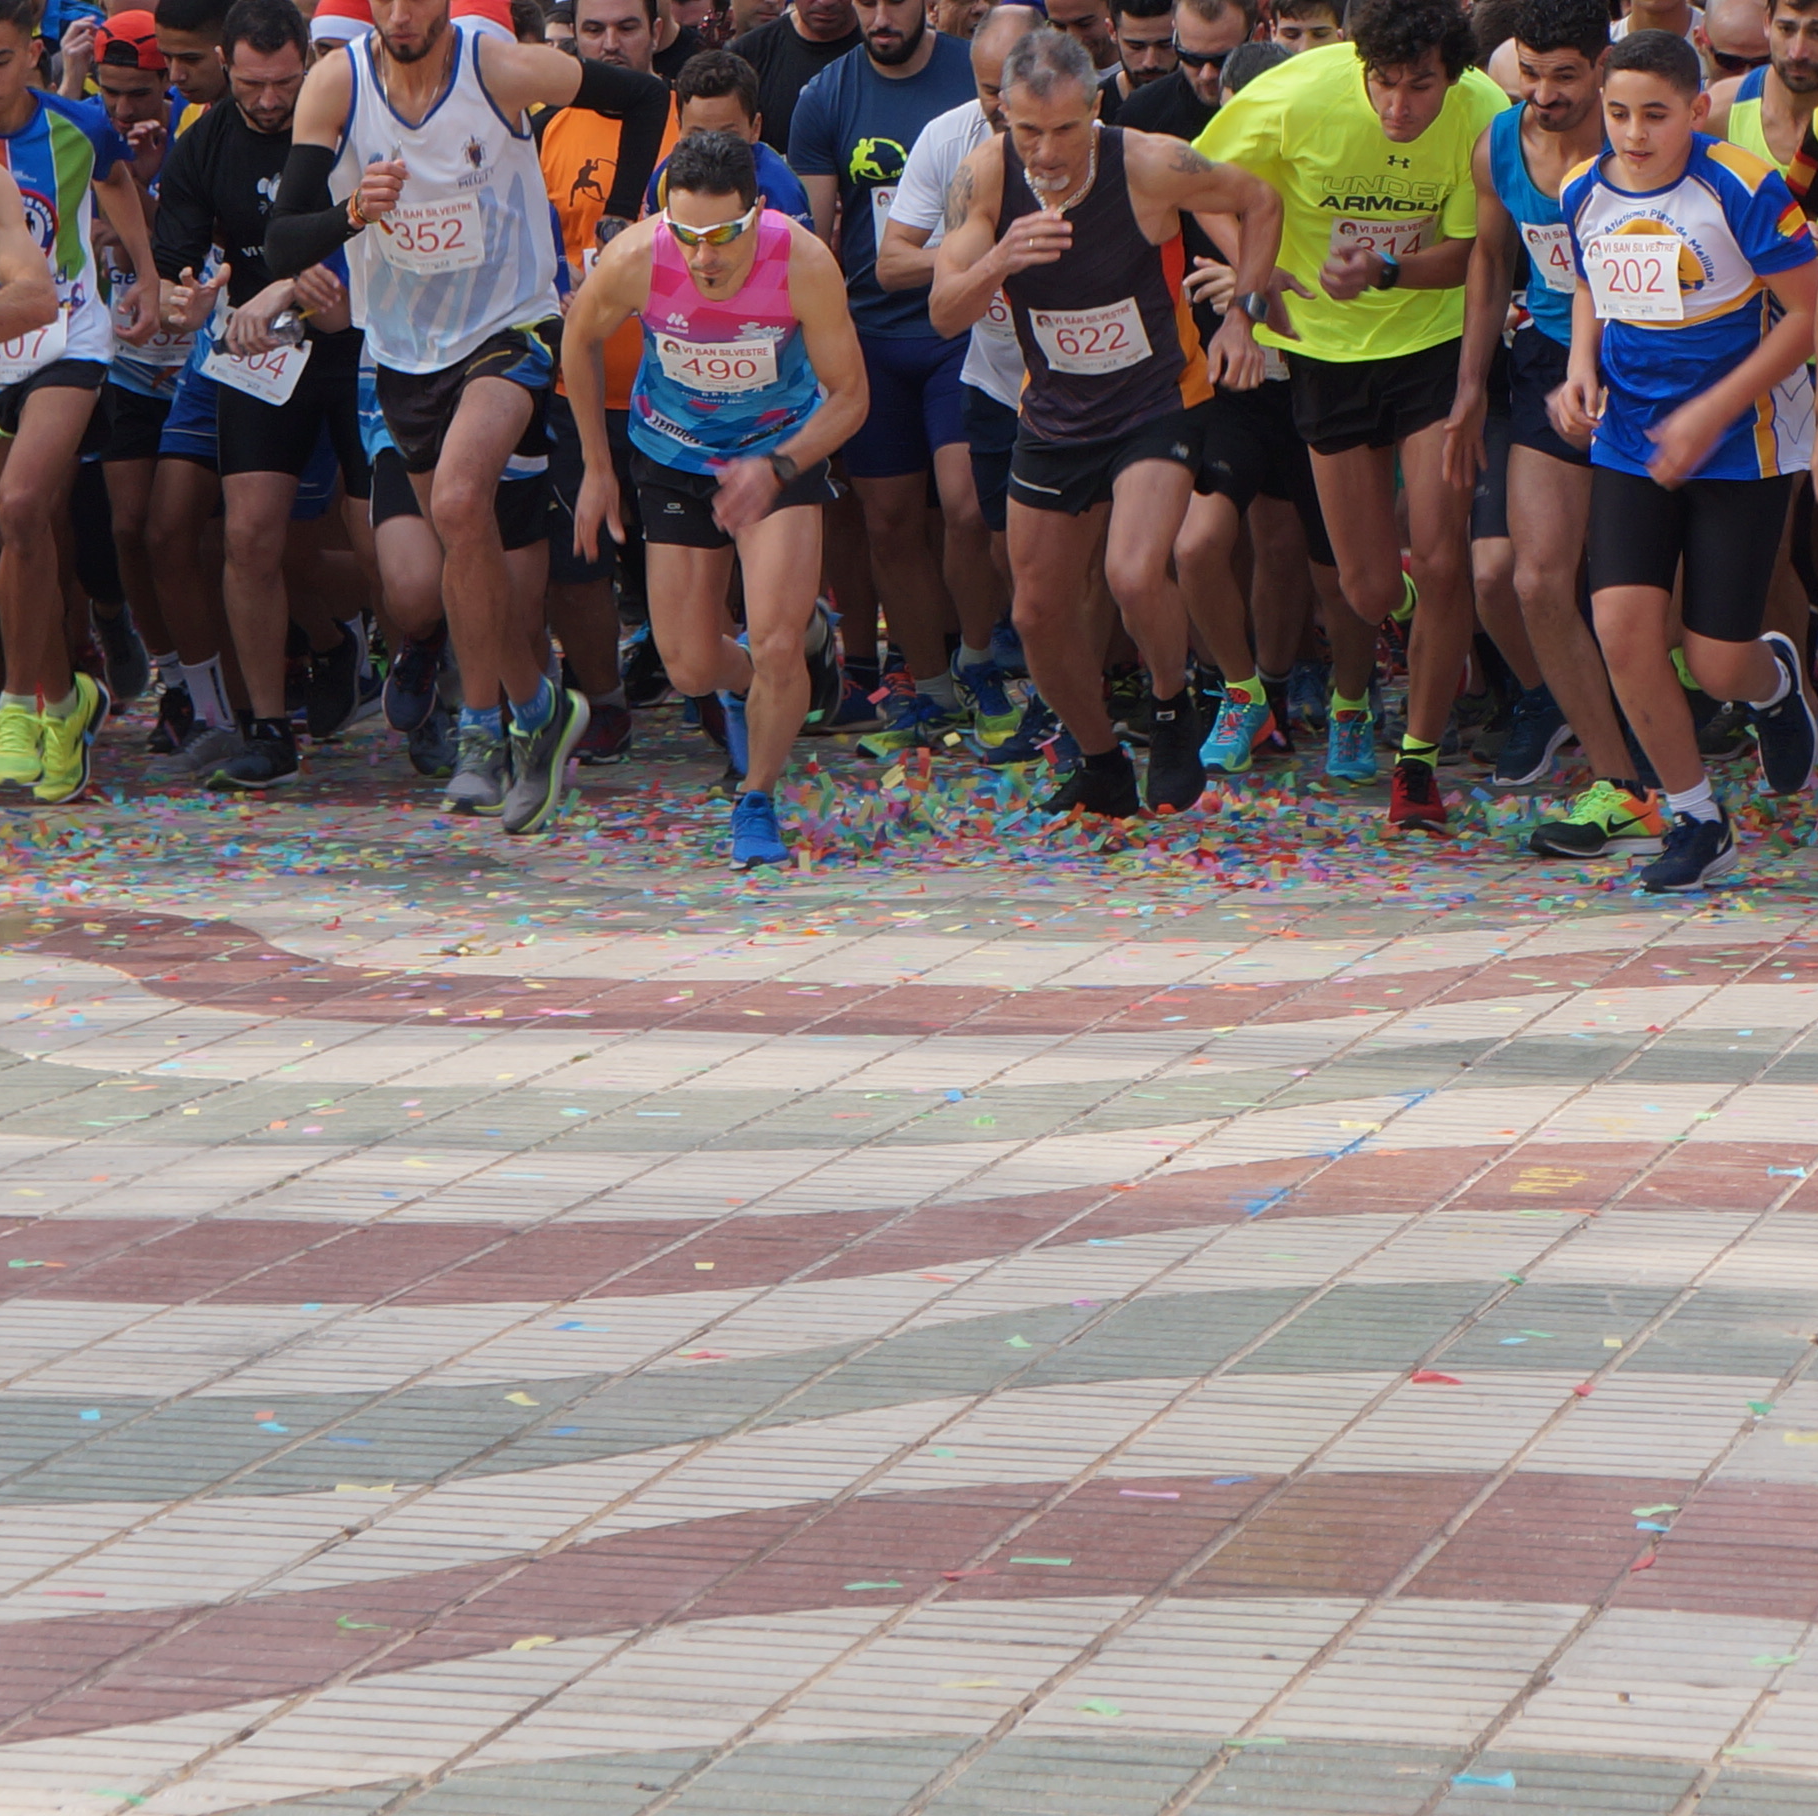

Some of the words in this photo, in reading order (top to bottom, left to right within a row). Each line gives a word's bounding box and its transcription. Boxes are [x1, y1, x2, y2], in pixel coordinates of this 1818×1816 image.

[403, 209, 423, 219] SAN
[426, 202, 473, 217] SILVESTRE
[1318, 195, 1439, 212] ARMOU
[394, 218, 465, 254] 352
[1372, 224, 1392, 233] SAN
[1541, 231, 1552, 240] VI
[1604, 242, 1612, 252] VI
[1613, 242, 1631, 253] SAN
[1633, 241, 1675, 252] SILVESTRE
[1603, 258, 1665, 293] 202
[1086, 304, 1131, 324] SILVESTRE
[1056, 322, 1130, 355] 622
[682, 345, 693, 355] VI
[695, 347, 716, 356] SAN
[718, 347, 768, 357] SILVESTRE
[682, 358, 757, 380] 490
